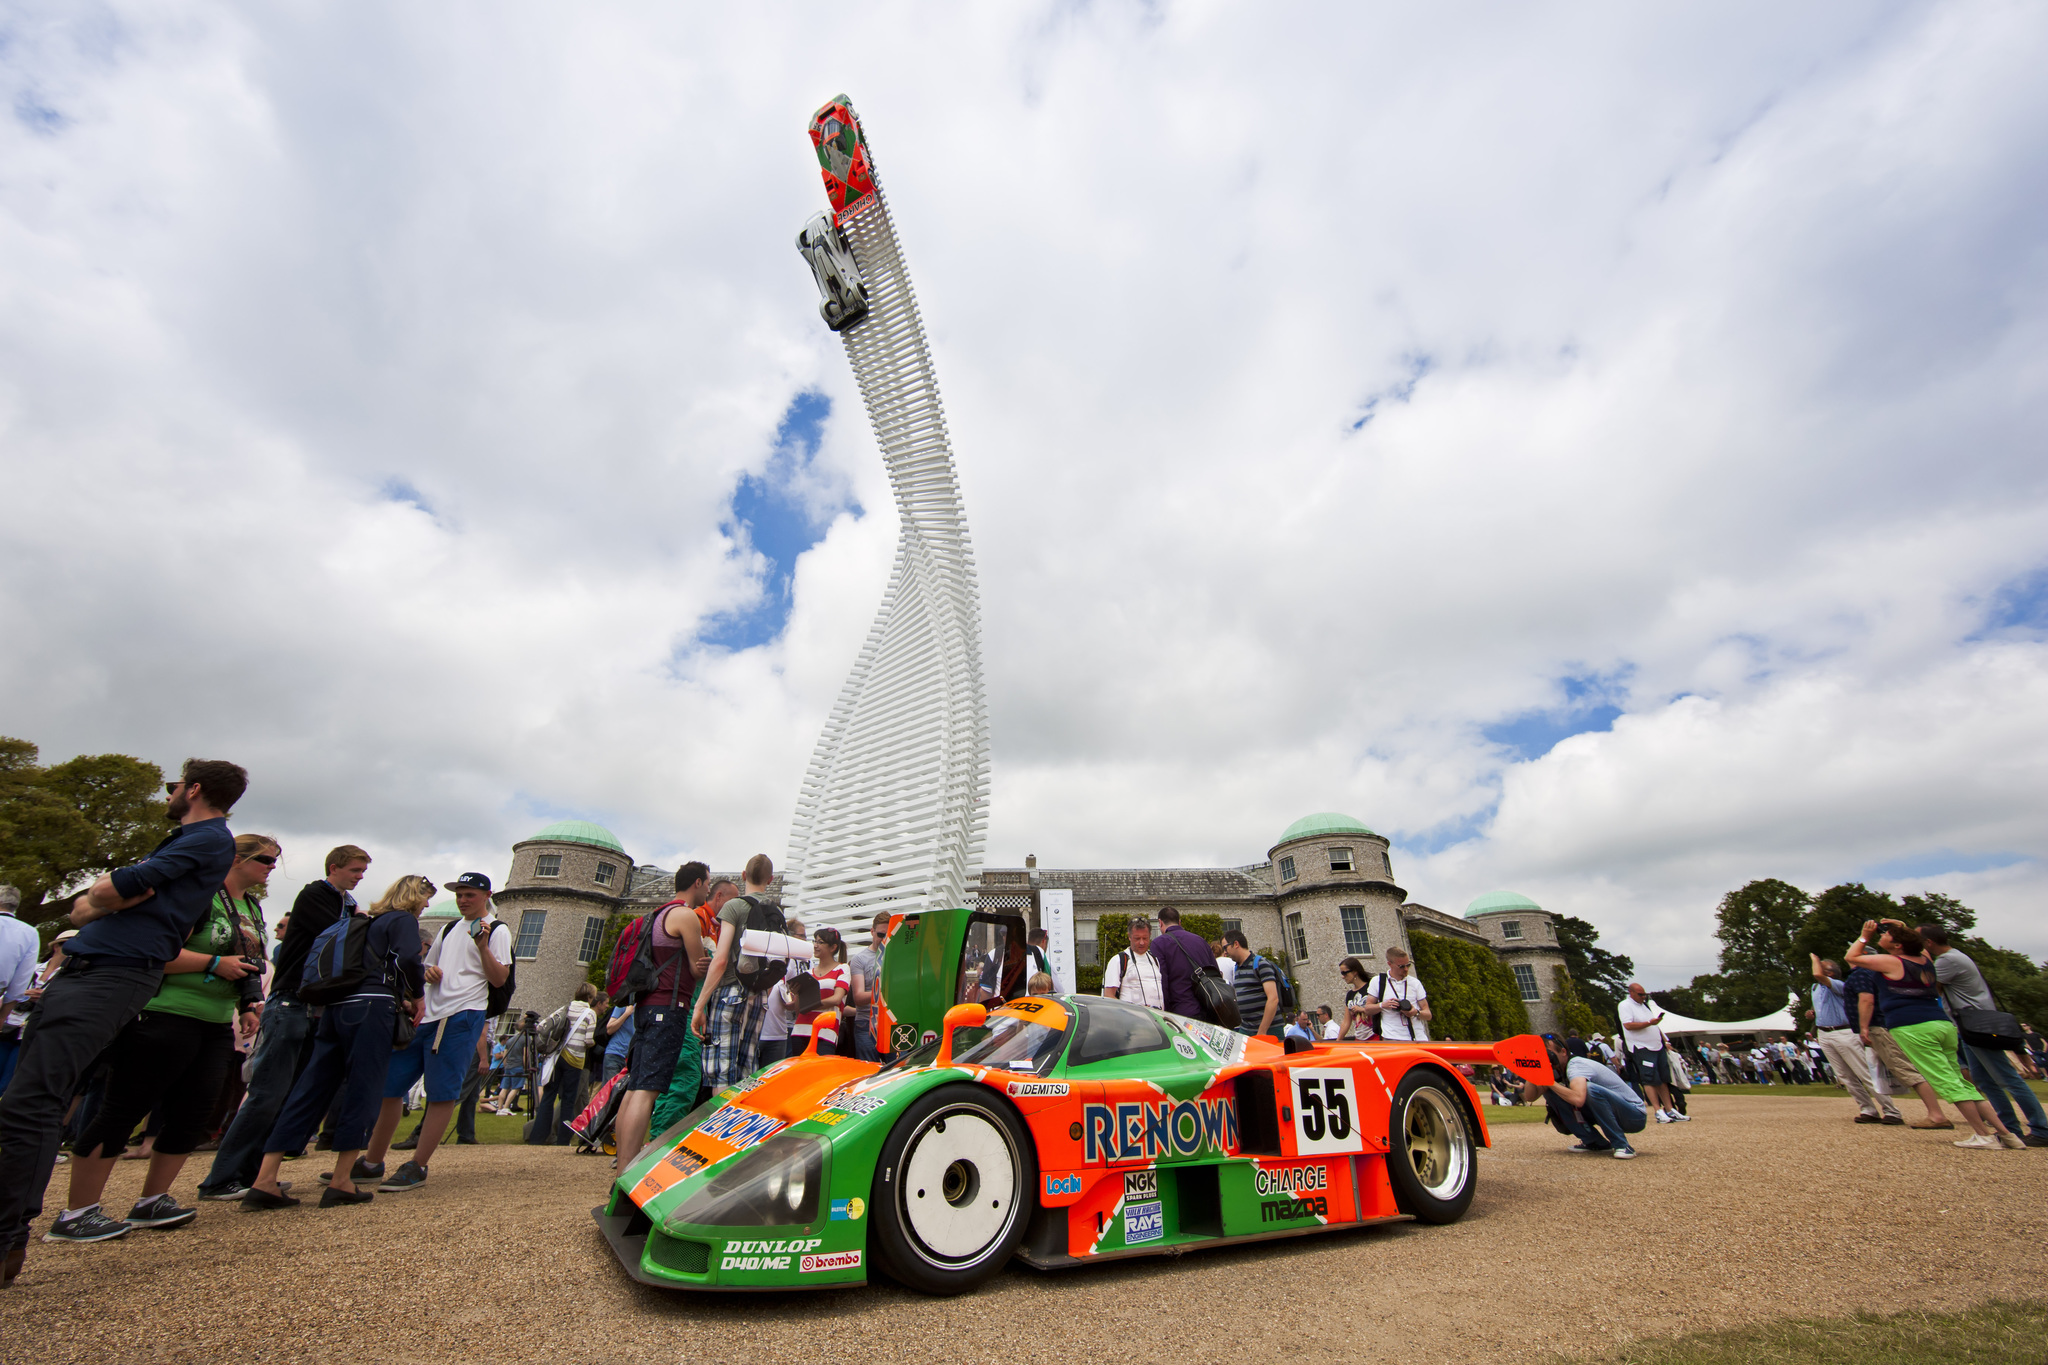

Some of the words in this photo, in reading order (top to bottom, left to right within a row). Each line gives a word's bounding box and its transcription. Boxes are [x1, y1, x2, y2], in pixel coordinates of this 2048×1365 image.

[837, 194, 874, 223] CHARGE
[1177, 1043, 1194, 1055] 788
[1515, 1058, 1541, 1068] mazda
[1020, 1084, 1068, 1095] IDEMITSU
[822, 1090, 887, 1116] CHARGE
[1298, 1078, 1352, 1141] 55
[693, 1105, 788, 1150] RENOWN
[1084, 1096, 1240, 1164] RENOWN
[1126, 1172, 1155, 1193] NGK
[1255, 1164, 1327, 1197] CHARGE
[1126, 1193, 1143, 1201] SPARK
[1143, 1191, 1157, 1199] PLUGS
[1261, 1196, 1328, 1222] mazda
[1126, 1213, 1162, 1233] RAYS
[1126, 1228, 1162, 1241] ENGINEERING
[723, 1239, 822, 1253] DUNLOP
[720, 1256, 791, 1270] D40/M2
[815, 1252, 860, 1268] brembo
